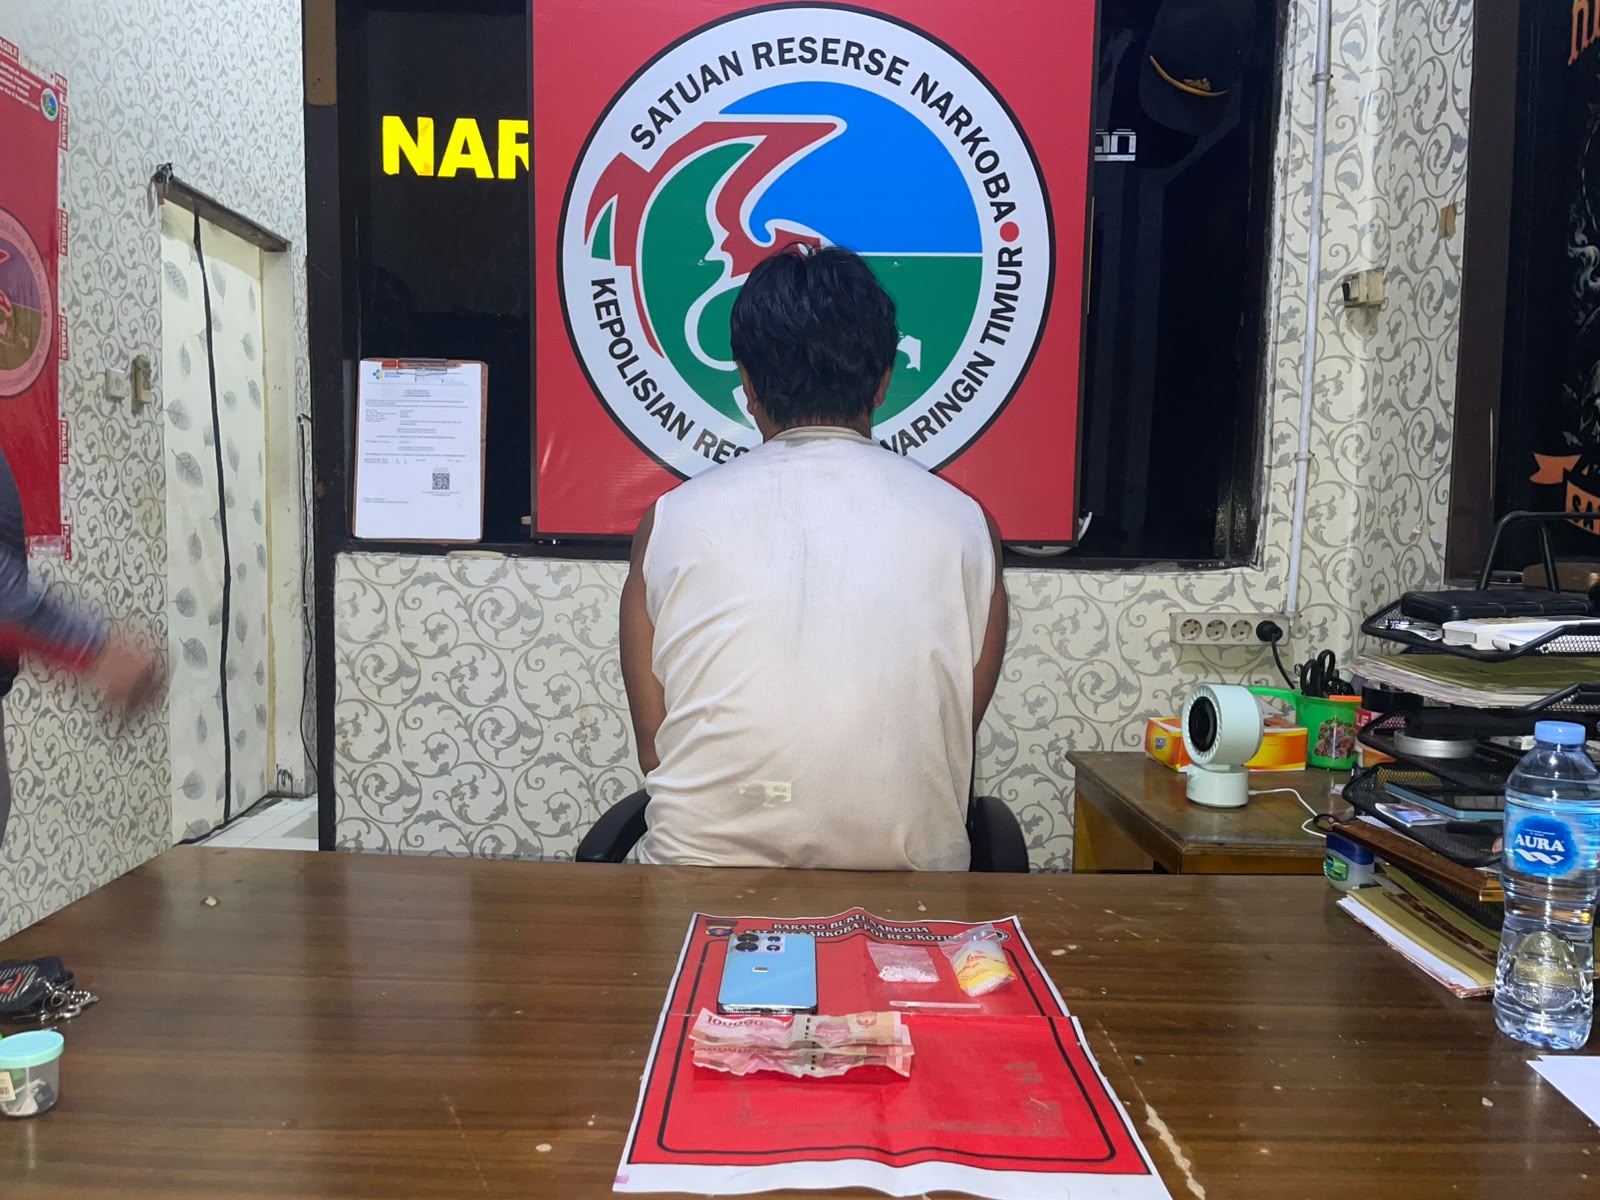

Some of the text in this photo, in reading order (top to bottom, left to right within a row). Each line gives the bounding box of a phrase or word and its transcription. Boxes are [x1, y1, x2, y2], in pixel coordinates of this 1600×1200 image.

[630, 36, 1017, 223] SATUAN RESERSE NARKOBA
[591, 277, 695, 442] KEPOLISIAN
[979, 246, 1023, 346] TIMUR
[1514, 833, 1566, 852] AURA
[830, 914, 865, 929] BUKTI
[870, 919, 930, 933] NARKOBA
[863, 924, 913, 940] POLRES
